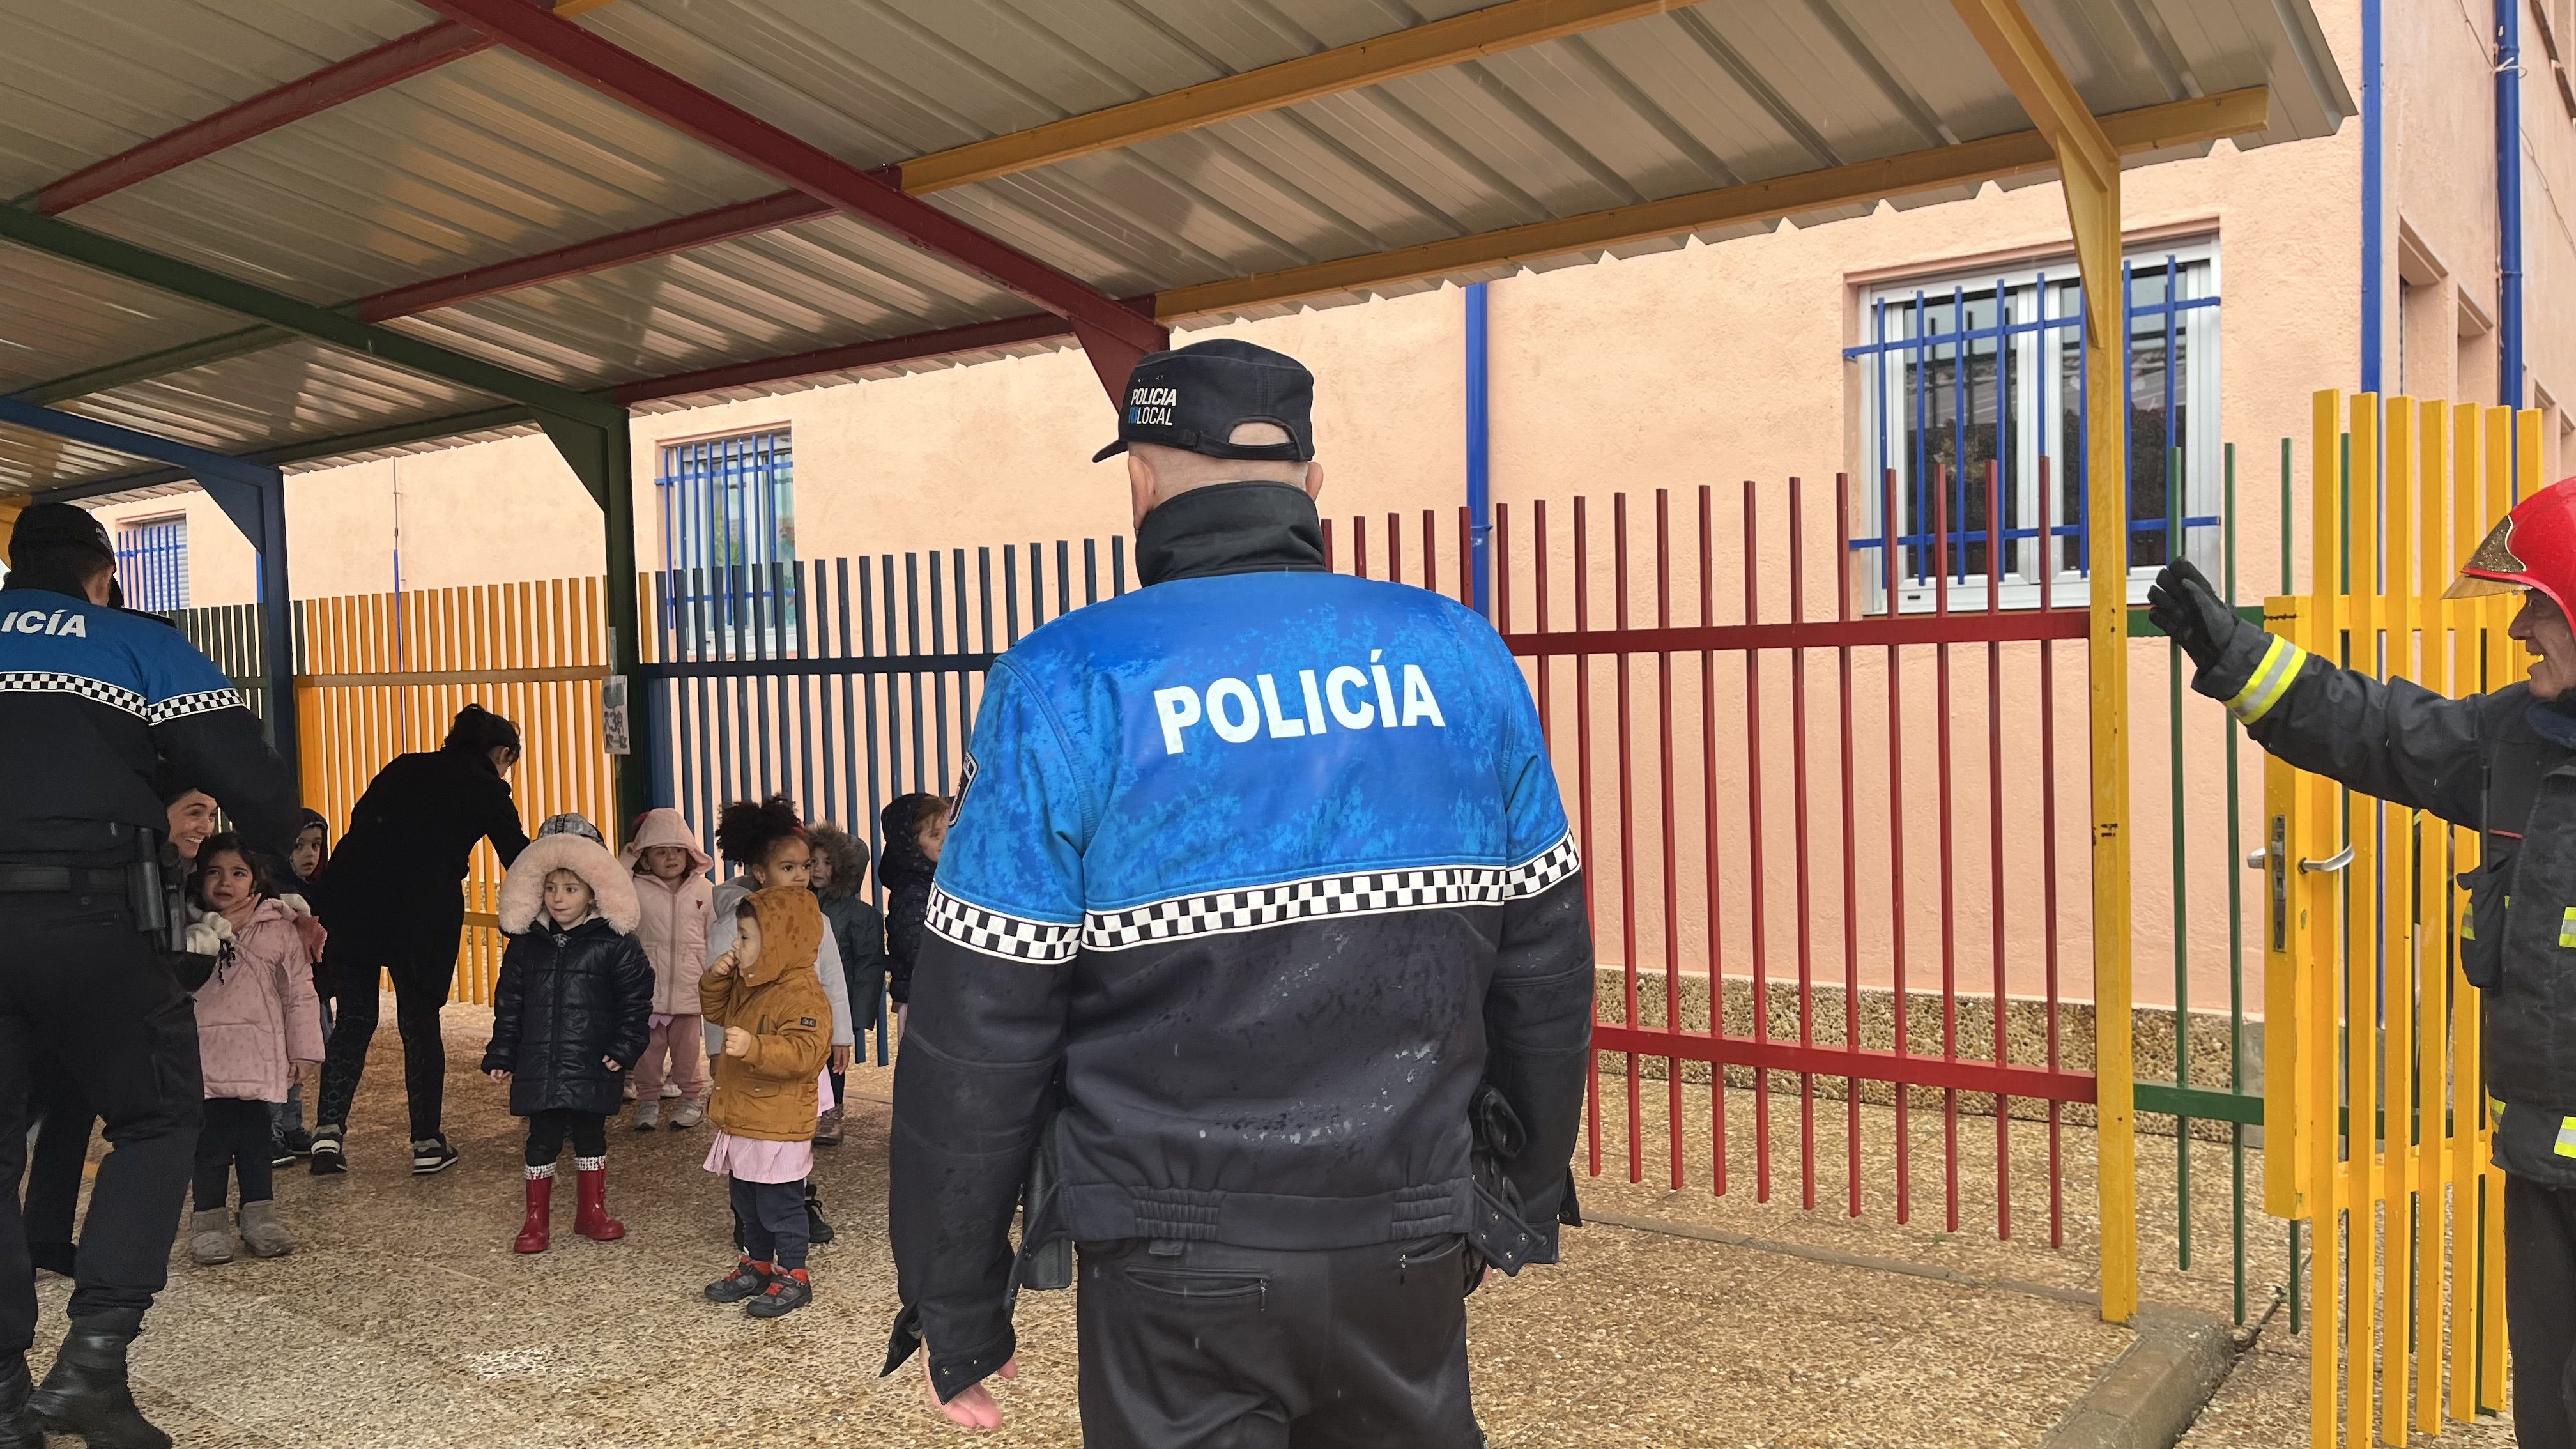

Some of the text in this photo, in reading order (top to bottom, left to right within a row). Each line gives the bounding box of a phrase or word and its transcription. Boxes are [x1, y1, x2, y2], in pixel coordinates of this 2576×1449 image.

[1130, 387, 1177, 406] POLICIA
[1137, 406, 1173, 425] LOCAL
[1153, 648, 1446, 755] POLICÍA
